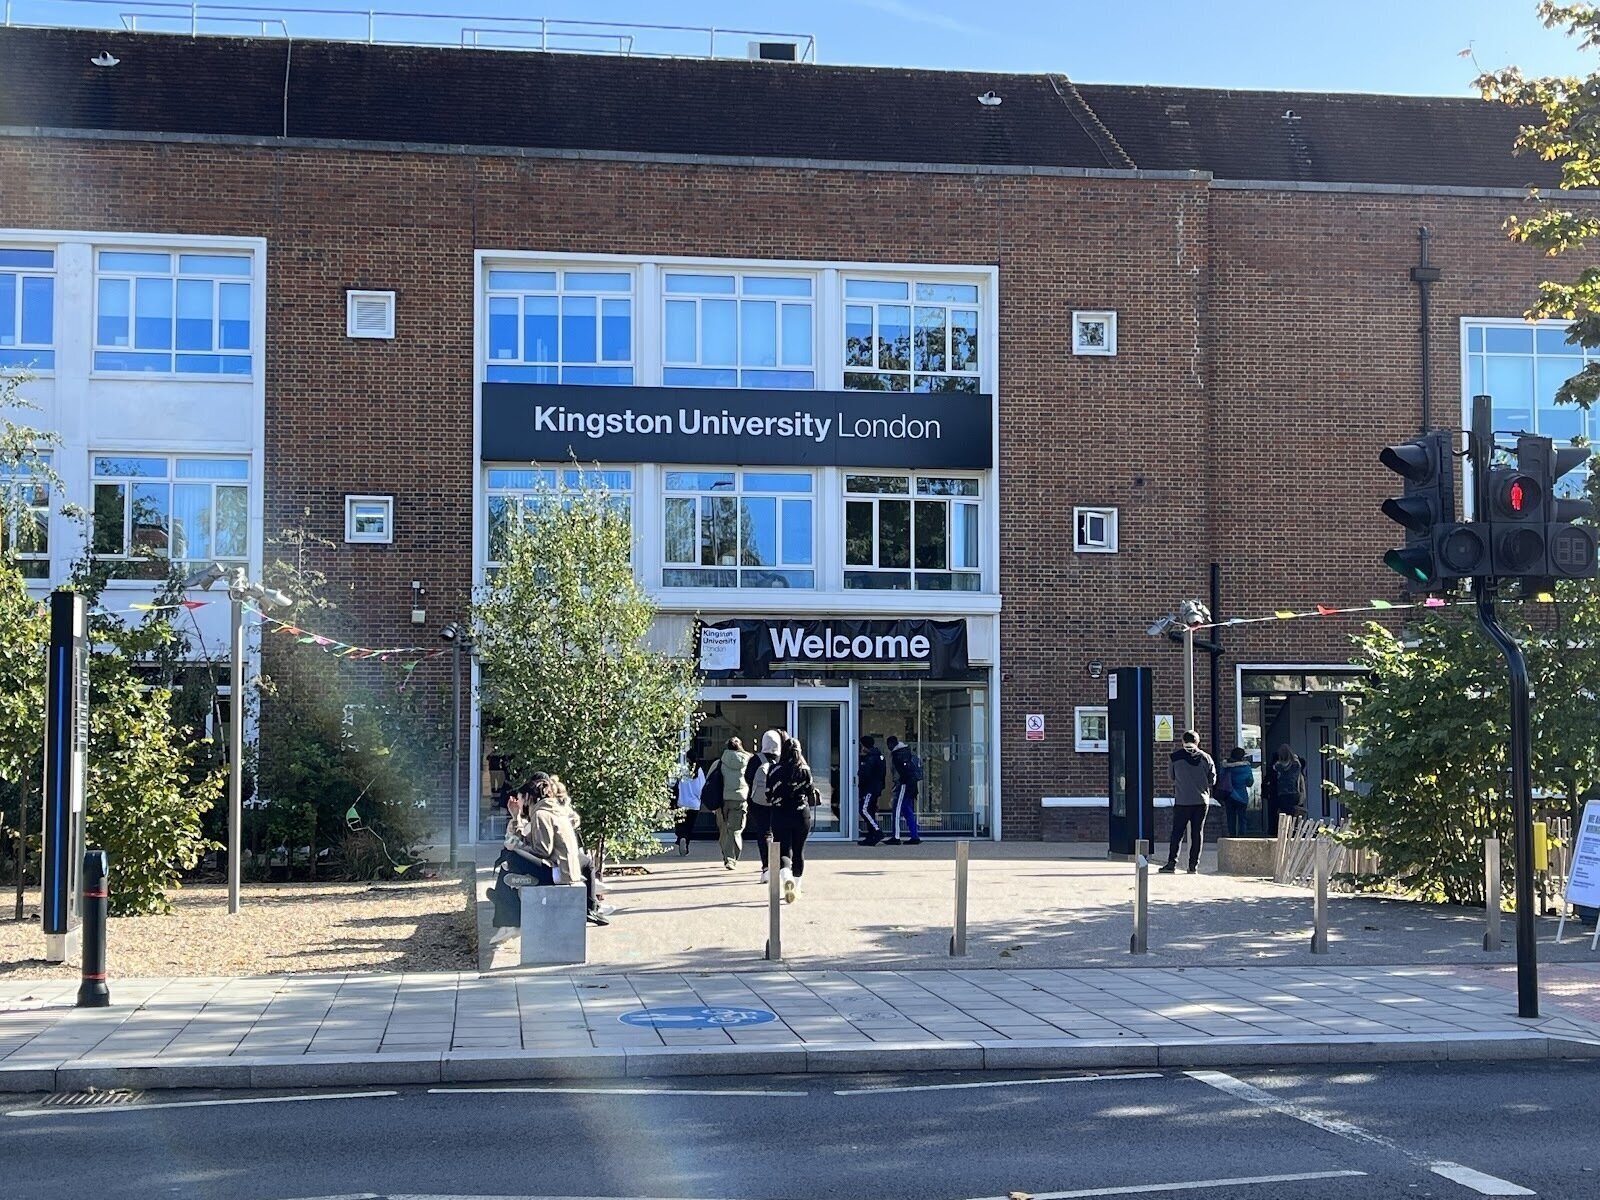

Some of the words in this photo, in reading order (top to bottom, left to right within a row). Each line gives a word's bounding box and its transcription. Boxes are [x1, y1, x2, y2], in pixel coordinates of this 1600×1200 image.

[535, 406, 672, 439] Kingston
[679, 409, 832, 443] University
[838, 412, 941, 440] London
[703, 630, 733, 638] Kingston
[769, 627, 931, 658] Welcome
